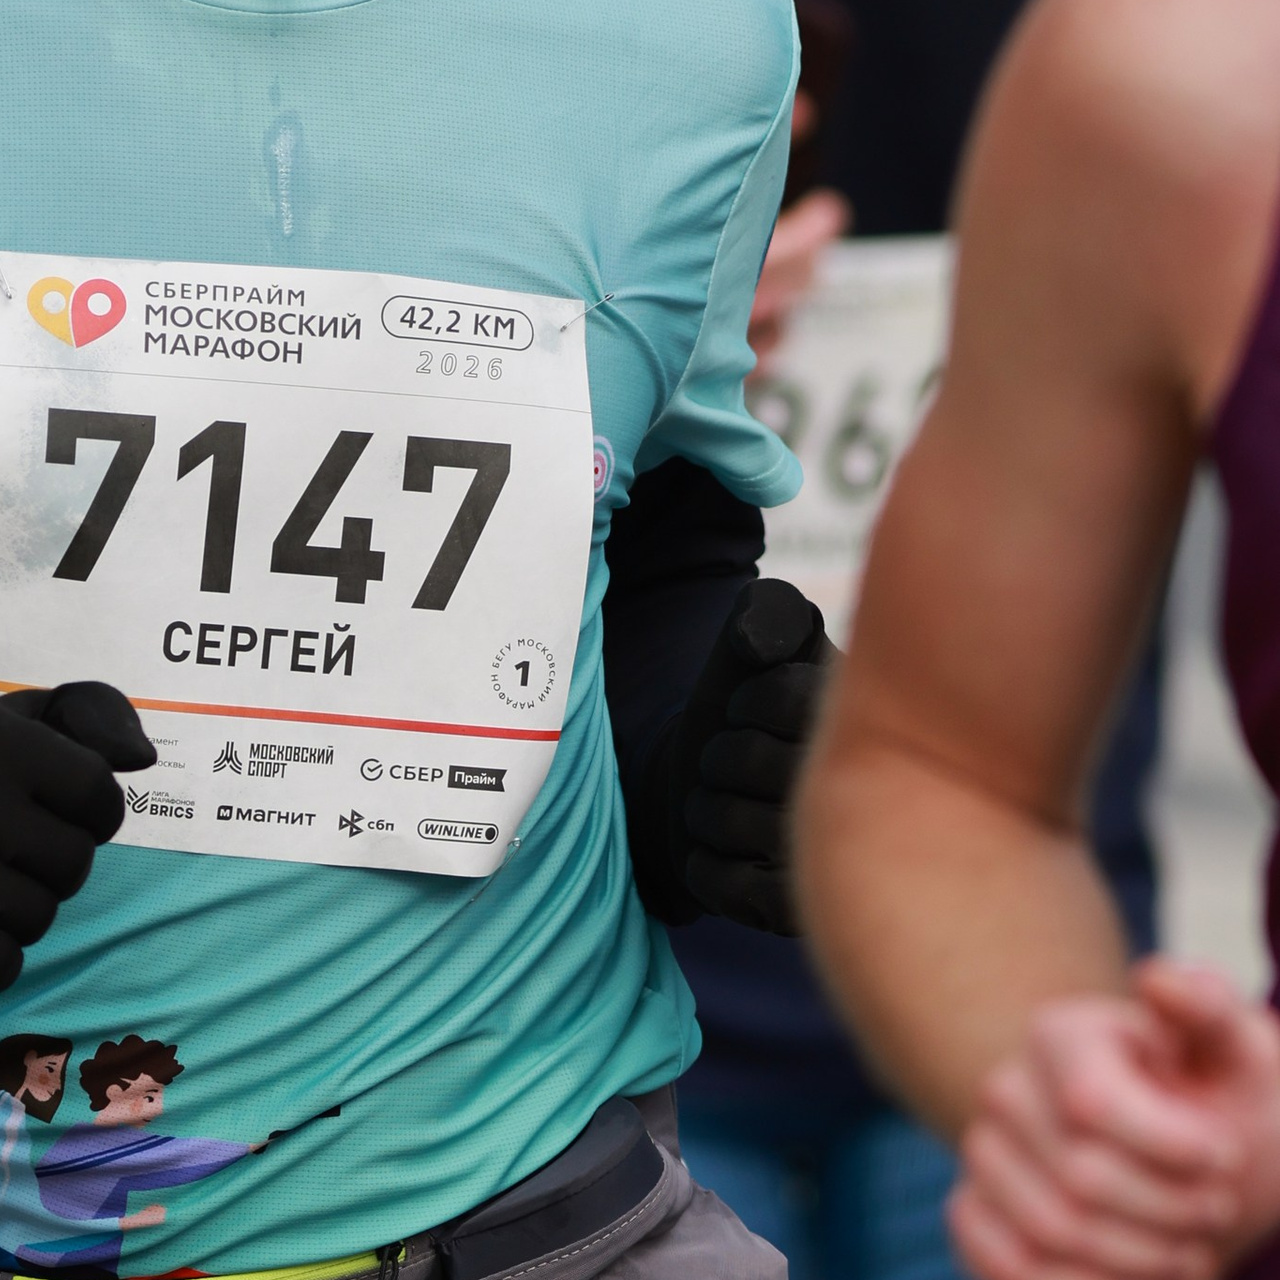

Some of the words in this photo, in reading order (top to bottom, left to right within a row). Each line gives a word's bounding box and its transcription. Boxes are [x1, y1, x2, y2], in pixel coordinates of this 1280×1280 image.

[145, 281, 306, 307] СБЕРПРАЙМ
[144, 304, 362, 340] МОСКОВСКИЙ
[399, 305, 462, 336] 42,2
[473, 313, 516, 341] КМ
[143, 332, 304, 365] МАРАФОН
[414, 350, 504, 380] 2026
[45, 407, 512, 612] 7147
[162, 620, 357, 677] СЕРГЕЙ
[491, 642, 512, 669] БЕГУ
[514, 660, 531, 687] 1
[490, 674, 536, 710] МАРАФОН
[155, 759, 186, 769] осквы
[249, 743, 335, 765] МОСКОВСКИЙ
[248, 760, 288, 778] СПОРТ
[389, 764, 444, 782] СБЕР
[454, 771, 497, 785] Прайм
[150, 796, 196, 806] МАРАФОНОВ
[151, 790, 170, 798] ЛИГА
[149, 803, 194, 819] BRICS
[236, 807, 317, 826] магнит
[367, 819, 395, 831] сбп
[424, 823, 484, 839] WINLINE
